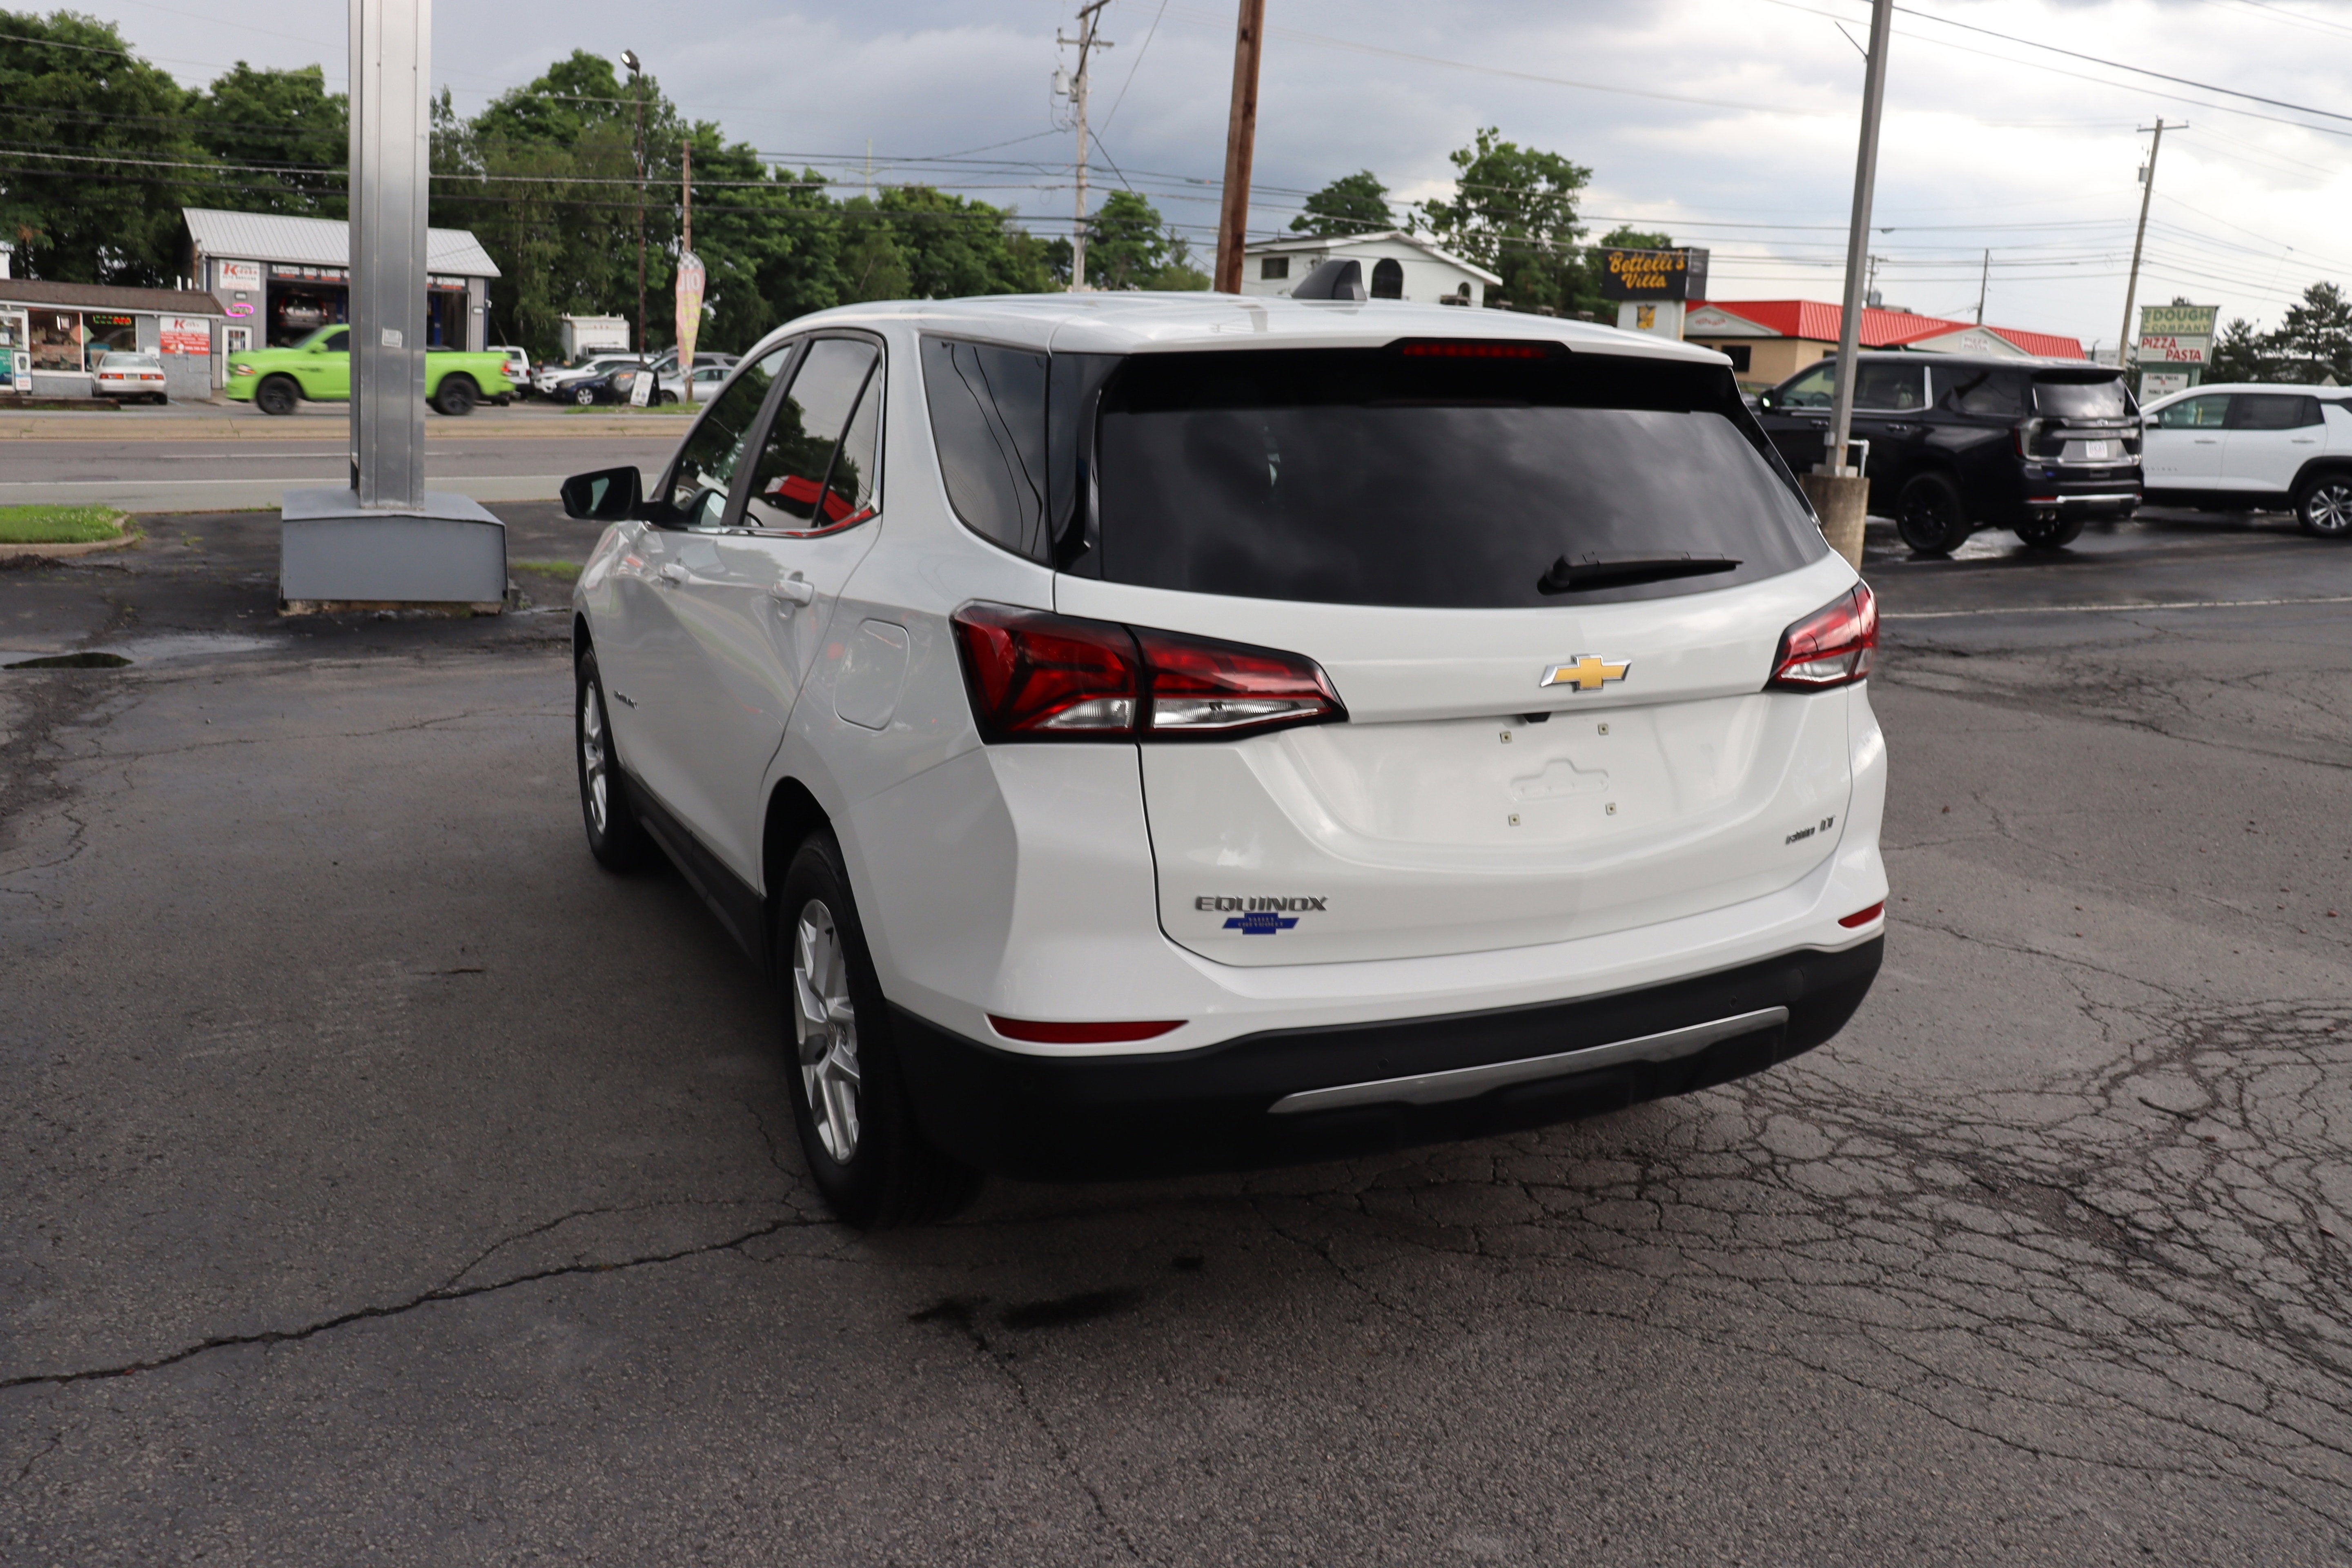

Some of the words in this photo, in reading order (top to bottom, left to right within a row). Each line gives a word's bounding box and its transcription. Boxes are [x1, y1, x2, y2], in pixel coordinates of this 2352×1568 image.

[1621, 271, 1668, 289] Villa
[2153, 310, 2211, 321] DOUGH
[2152, 324, 2210, 332] COMPANY
[2142, 336, 2177, 349] PIZZA
[2165, 349, 2202, 361] PASTA
[1820, 814, 1836, 832] LT
[1196, 895, 1328, 911] EQUINOX
